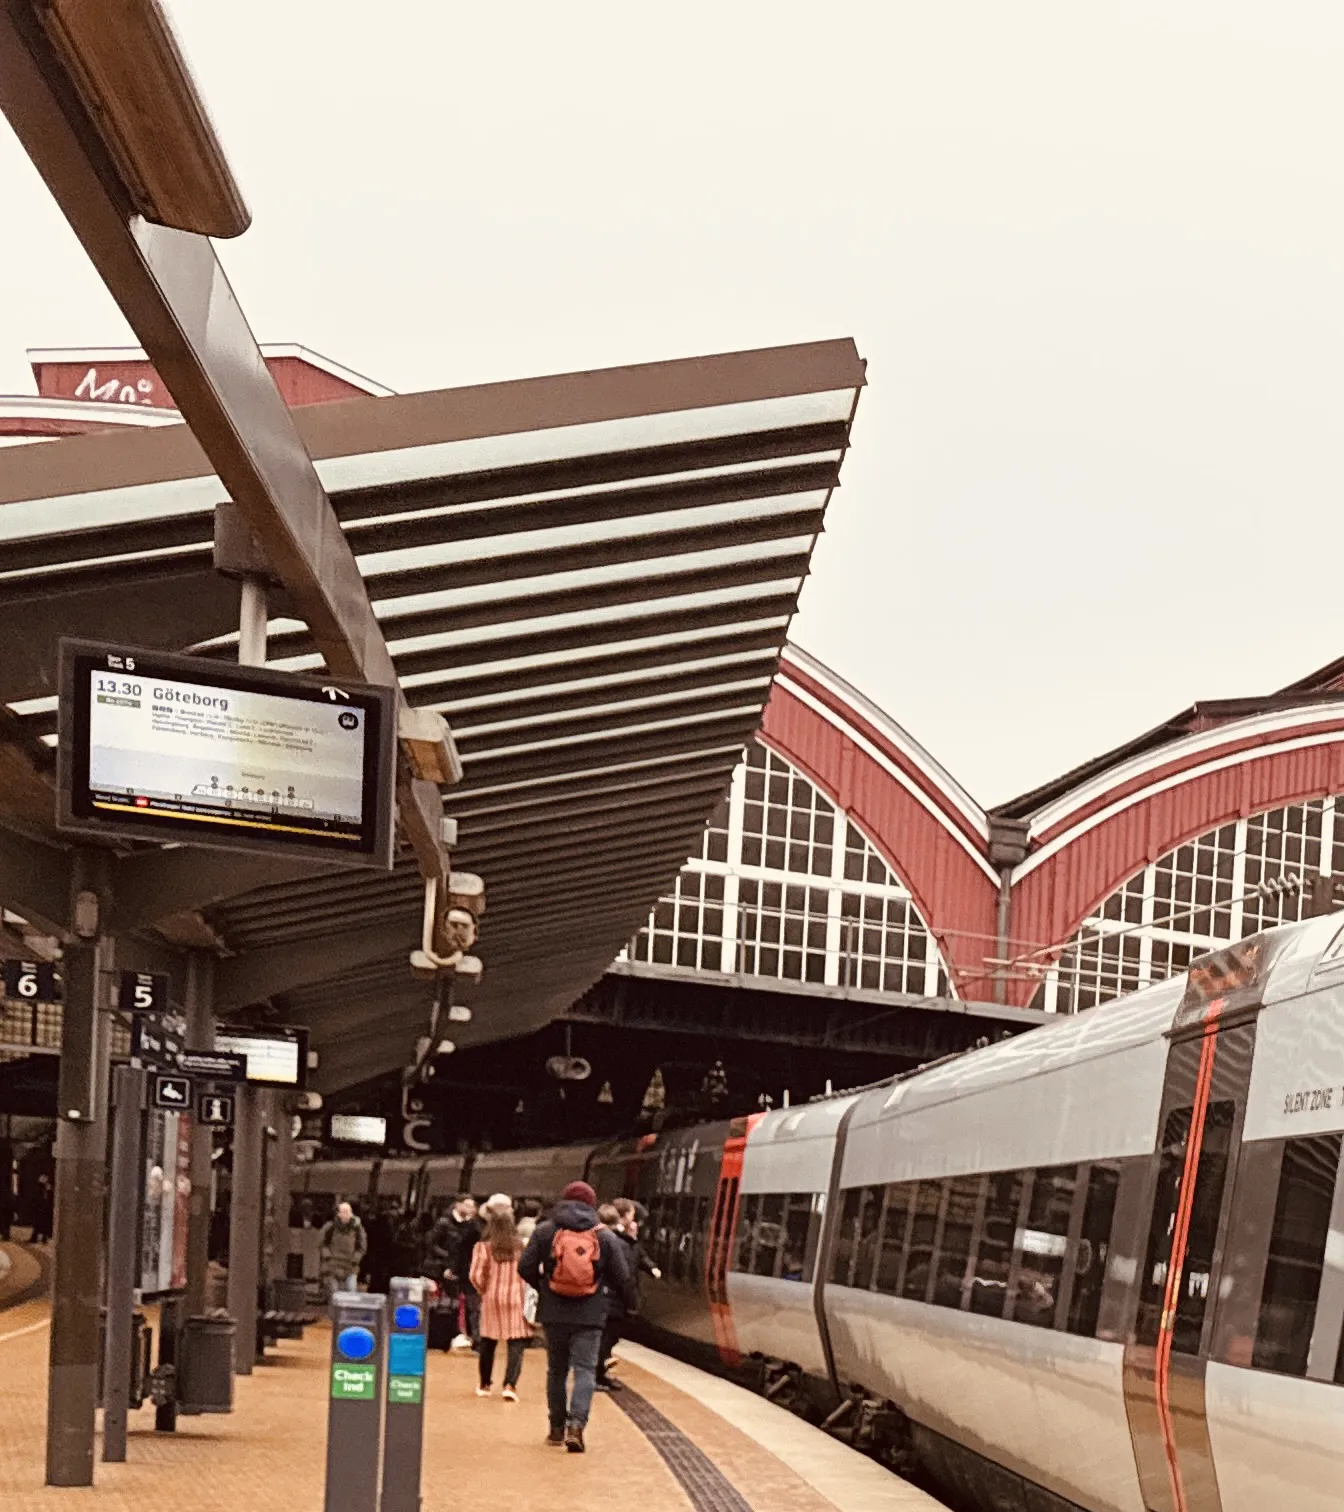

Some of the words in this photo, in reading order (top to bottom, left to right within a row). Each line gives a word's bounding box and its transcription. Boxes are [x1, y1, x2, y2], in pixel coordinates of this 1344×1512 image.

[125, 657, 135, 670] 5
[96, 680, 142, 696] 13.30
[153, 687, 228, 711] Göteborg
[17, 974, 37, 996] 6
[134, 986, 153, 1008] 5
[1283, 1090, 1310, 1114] SILENT
[1310, 1087, 1333, 1111] ZONE
[334, 1369, 374, 1382] Check
